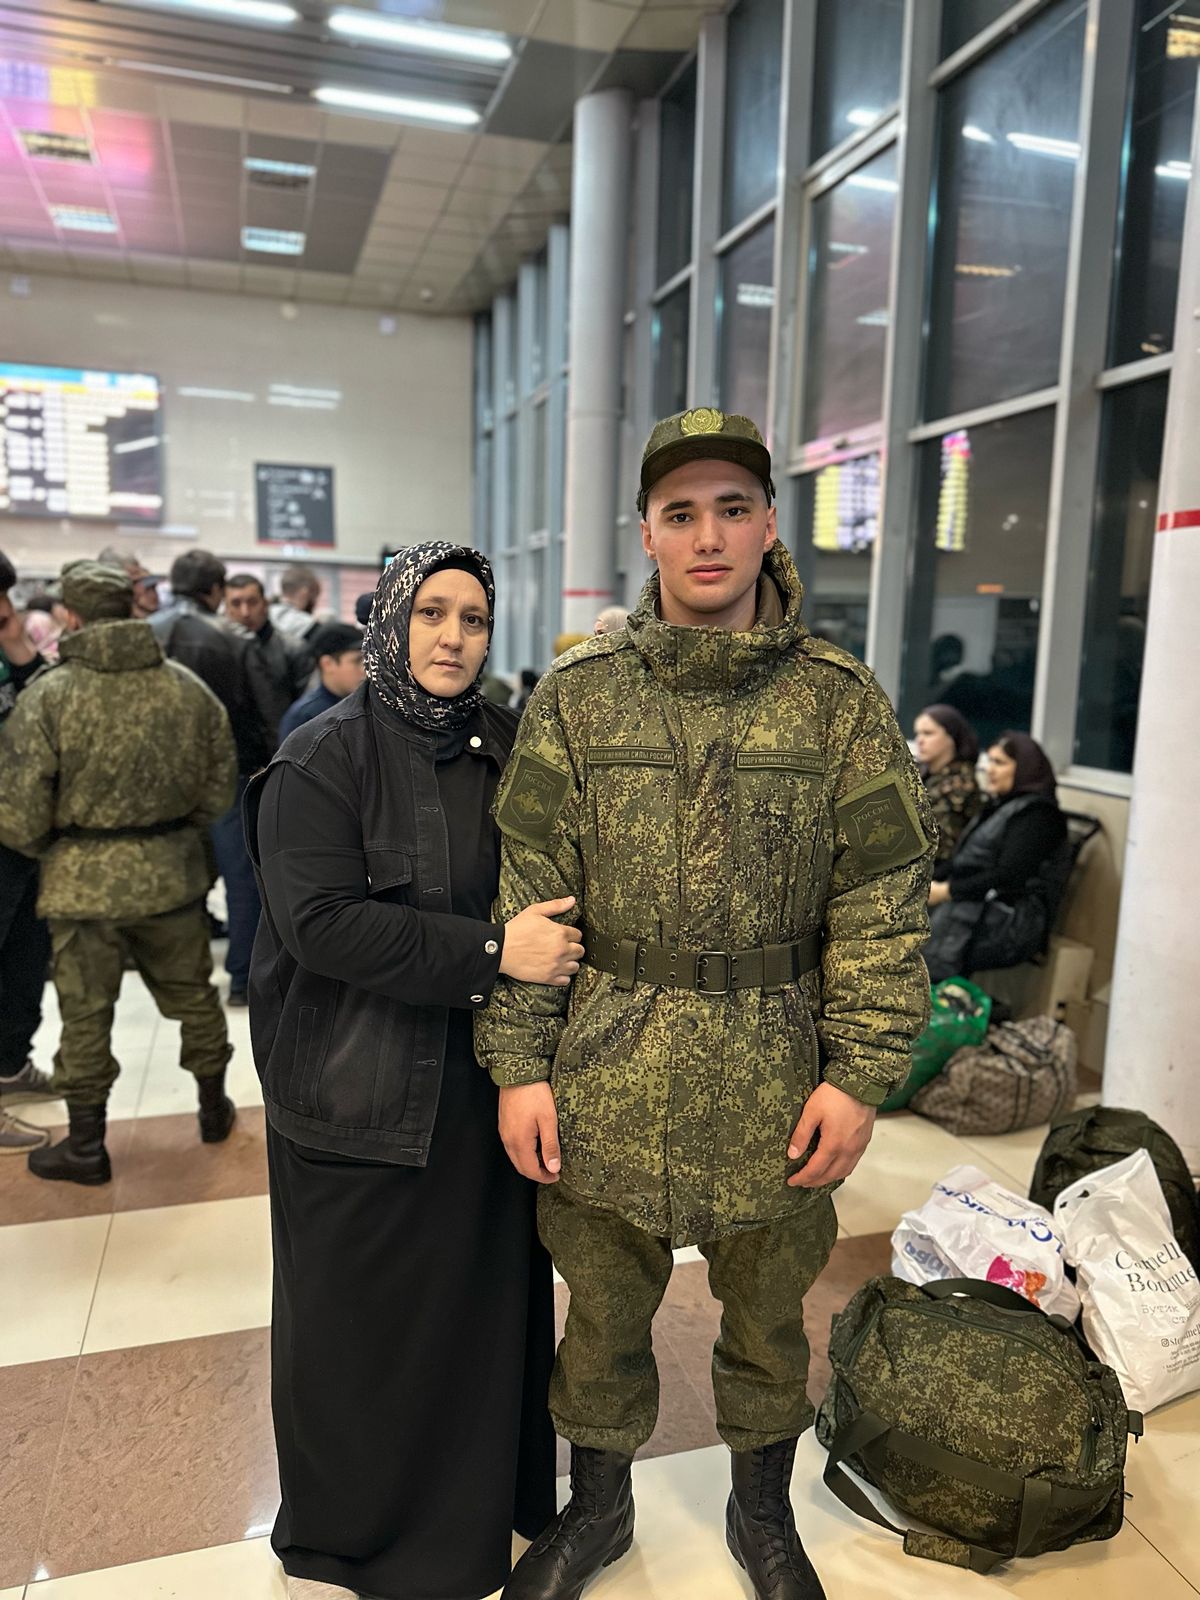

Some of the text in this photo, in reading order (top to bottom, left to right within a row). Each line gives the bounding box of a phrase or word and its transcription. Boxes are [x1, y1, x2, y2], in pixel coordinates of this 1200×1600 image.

[631, 751, 649, 760] СИЛЫ
[649, 752, 672, 760] РОССИИ
[739, 756, 782, 765] ВООРУЖЕННЫЕ
[801, 758, 824, 768] РОССИИ
[524, 773, 552, 793] РОССИЯ
[856, 803, 890, 824] РОССИЯ
